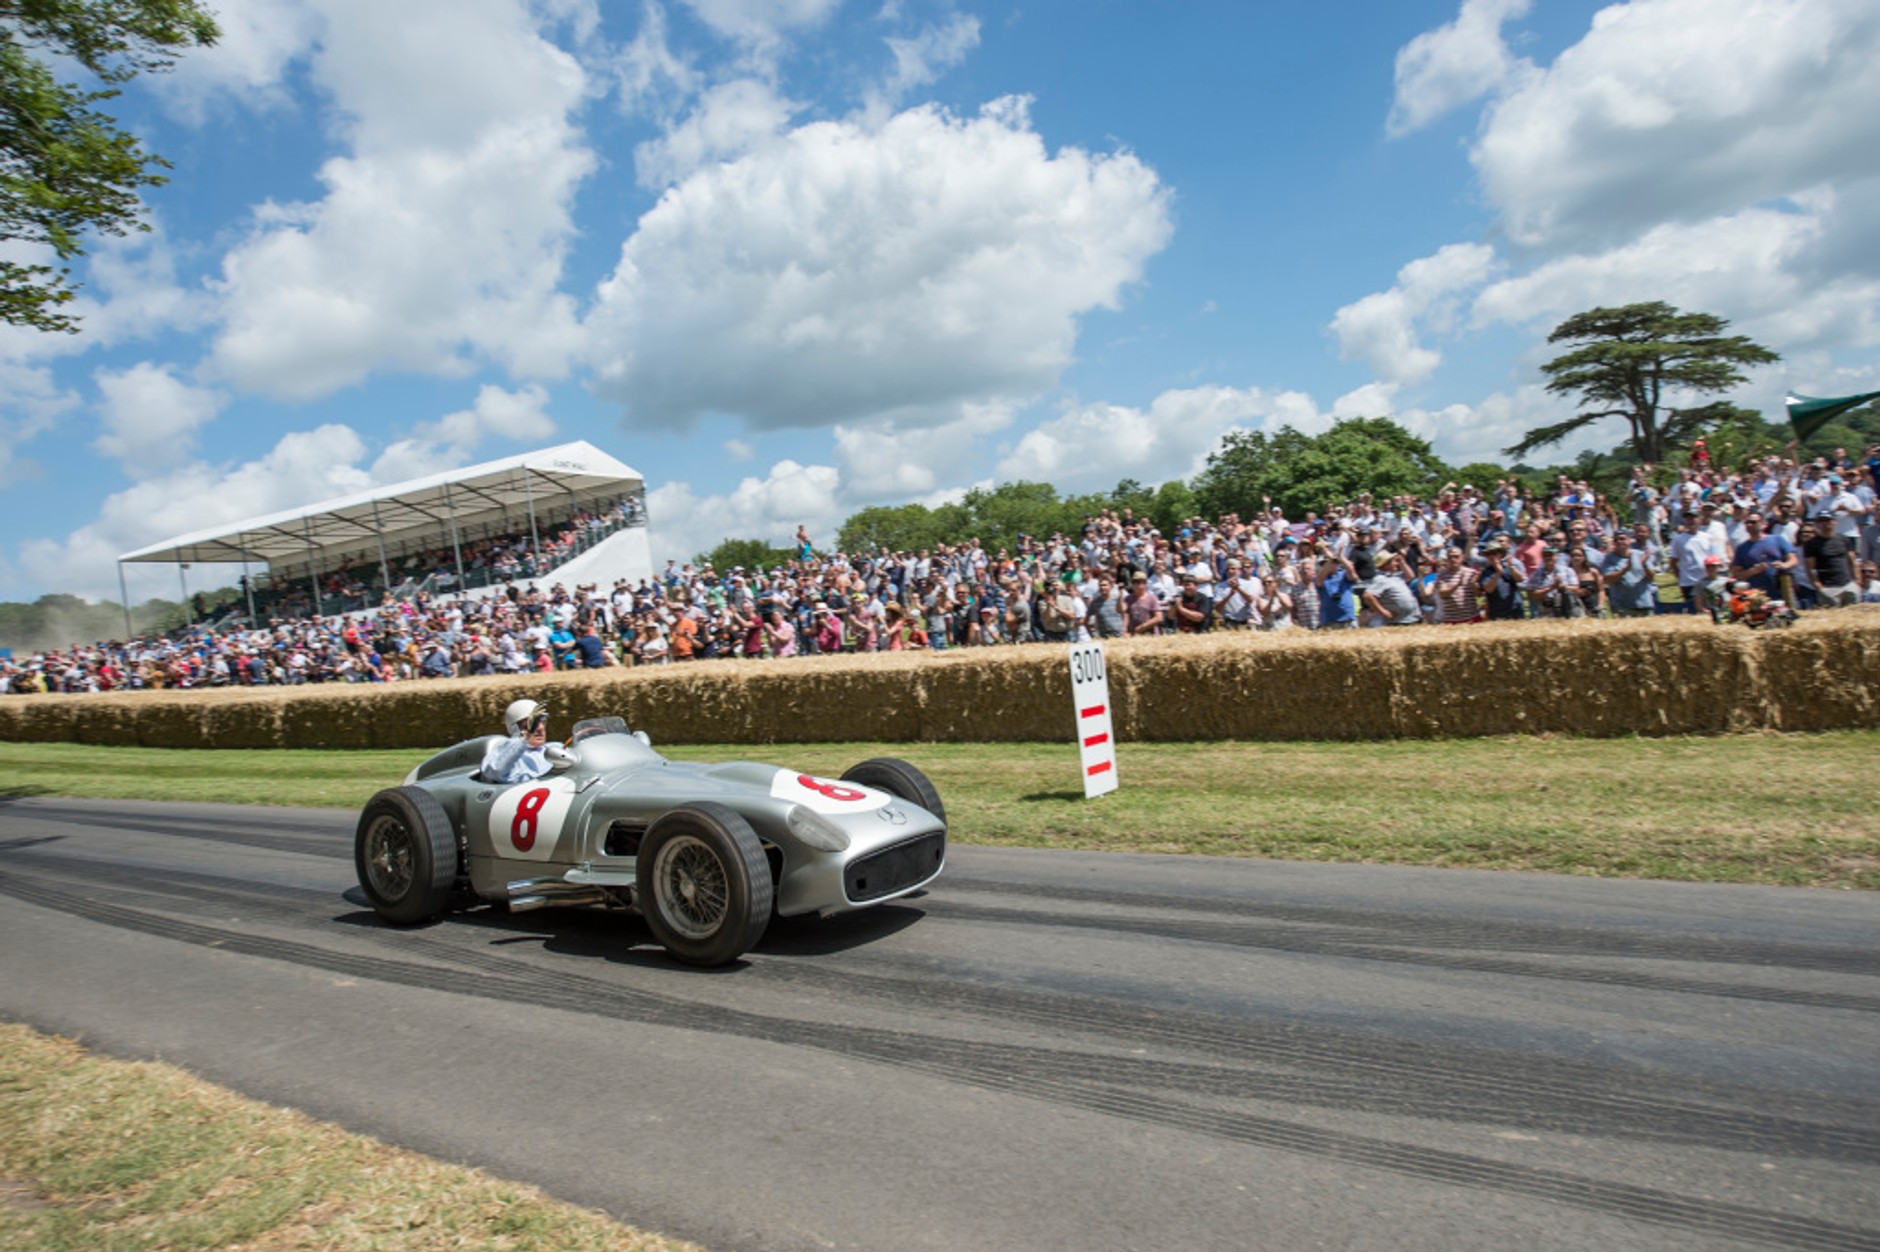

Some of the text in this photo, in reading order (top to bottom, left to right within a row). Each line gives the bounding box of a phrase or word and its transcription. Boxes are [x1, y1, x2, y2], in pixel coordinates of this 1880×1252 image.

[1073, 648, 1102, 684] 300
[797, 774, 866, 801] 8
[511, 788, 550, 852] 8
